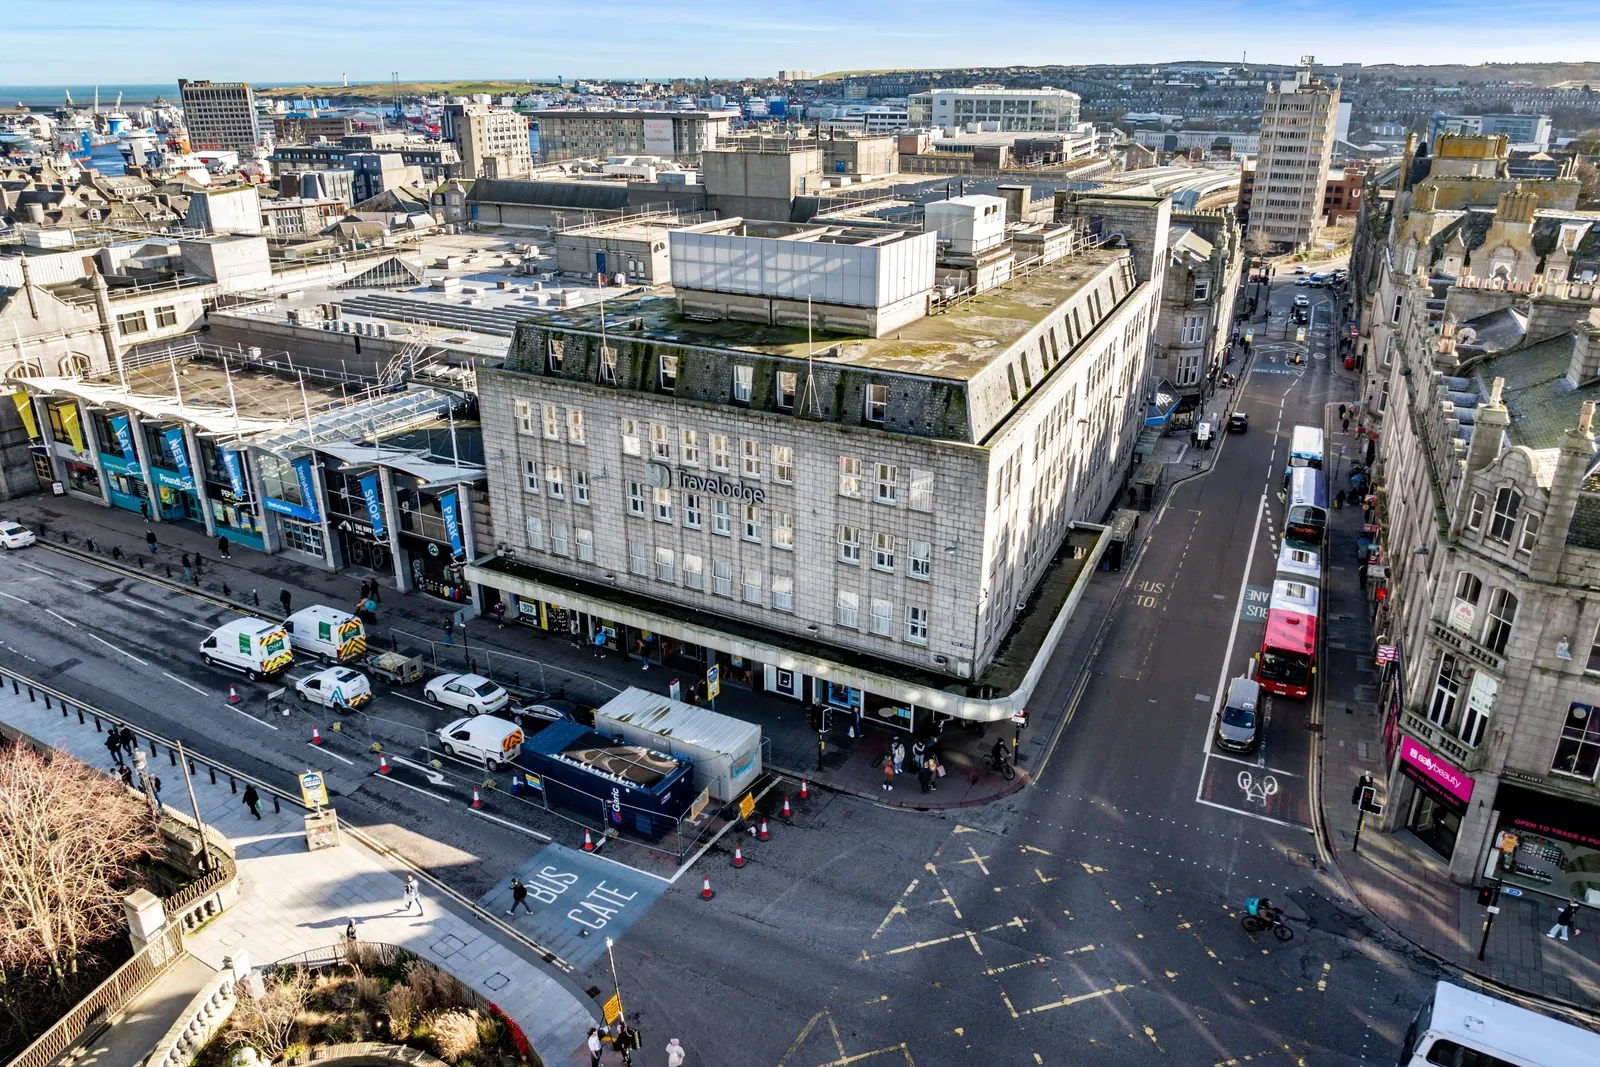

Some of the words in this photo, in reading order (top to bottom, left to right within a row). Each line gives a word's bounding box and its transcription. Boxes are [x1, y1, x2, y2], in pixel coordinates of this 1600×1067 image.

[117, 432, 132, 452] EAT
[169, 438, 187, 468] MEET
[297, 465, 316, 514] TrinityAberdeen
[675, 467, 765, 506] Travelodge
[364, 488, 381, 521] SHOP
[443, 505, 459, 540] PARK
[1134, 580, 1166, 594] BUS
[1247, 589, 1270, 602] ANE
[239, 644, 251, 653] CHAP
[268, 641, 285, 652] CHAP
[1406, 767, 1419, 778] OPEN
[1424, 778, 1440, 793] TRADE
[1443, 791, 1461, 807] PUBLIC
[1520, 775, 1542, 783] STREET
[612, 787, 621, 812] Garic
[1514, 818, 1537, 829] OPEN
[1551, 828, 1579, 840] TRADE
[1588, 837, 1600, 847] PU
[523, 865, 579, 905] BUS
[567, 880, 639, 930] GATE
